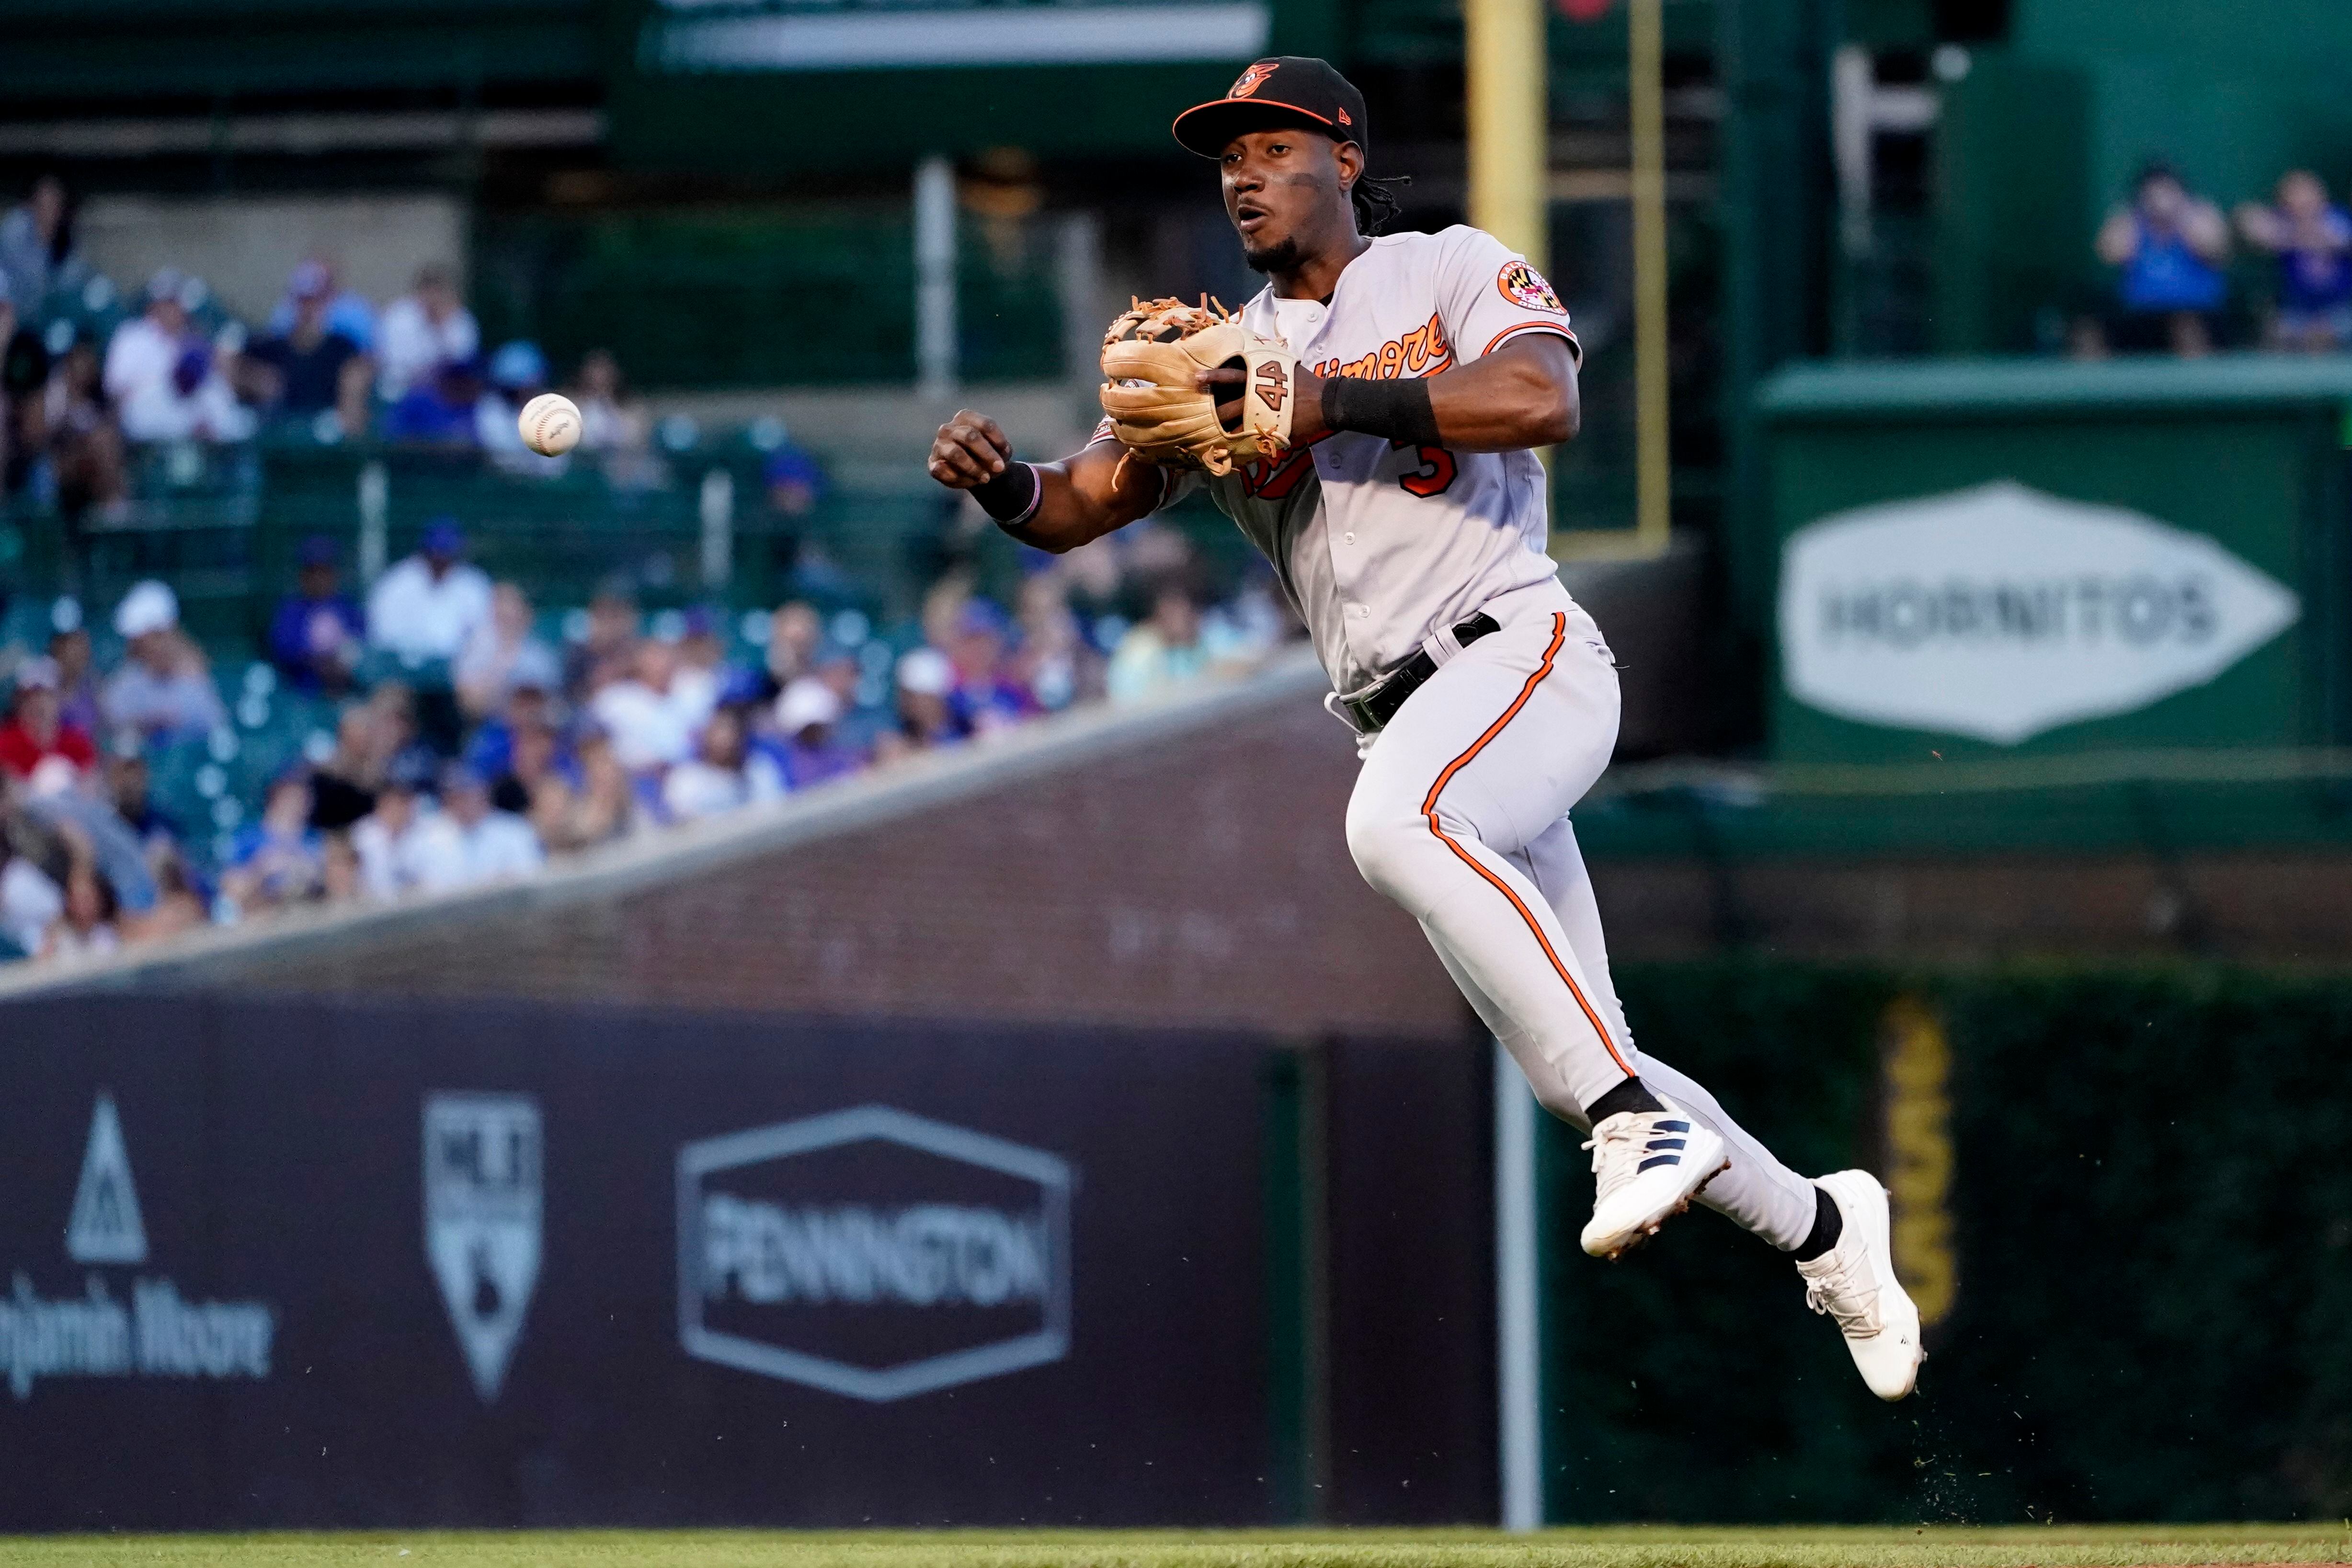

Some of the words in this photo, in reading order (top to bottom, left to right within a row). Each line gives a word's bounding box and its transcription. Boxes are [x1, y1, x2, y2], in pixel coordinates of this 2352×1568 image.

[1255, 360, 1289, 412] 44
[1390, 439, 1458, 498] 3
[1818, 572, 2219, 647] HORNITOS
[700, 1192, 1046, 1305] PENNINGTON
